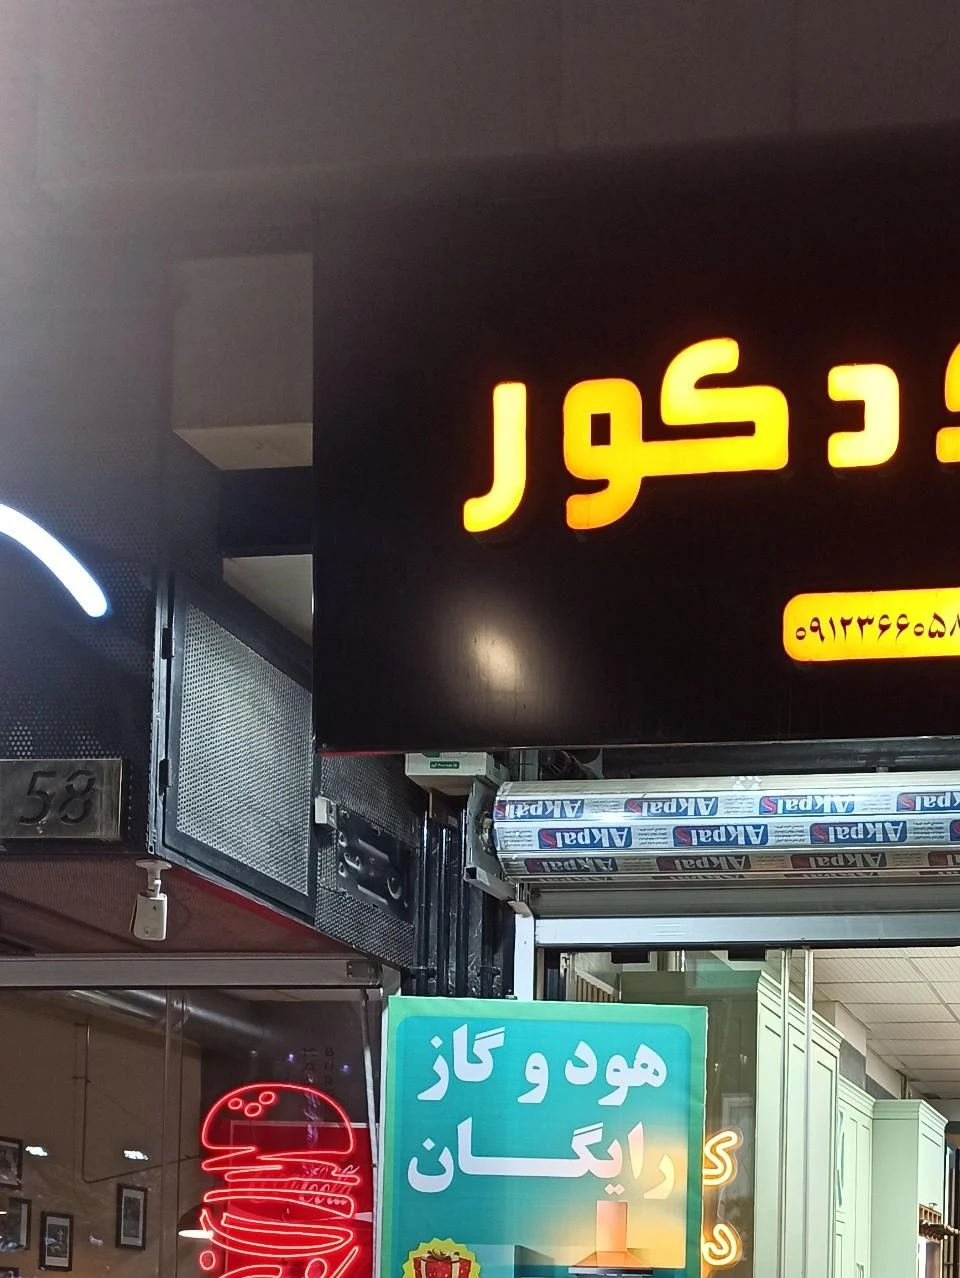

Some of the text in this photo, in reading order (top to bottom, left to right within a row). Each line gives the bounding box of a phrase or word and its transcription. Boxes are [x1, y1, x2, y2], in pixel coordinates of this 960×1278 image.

[462, 336, 900, 533] دکور
[19, 769, 96, 824] 58
[417, 1023, 668, 1106] هود و گاز
